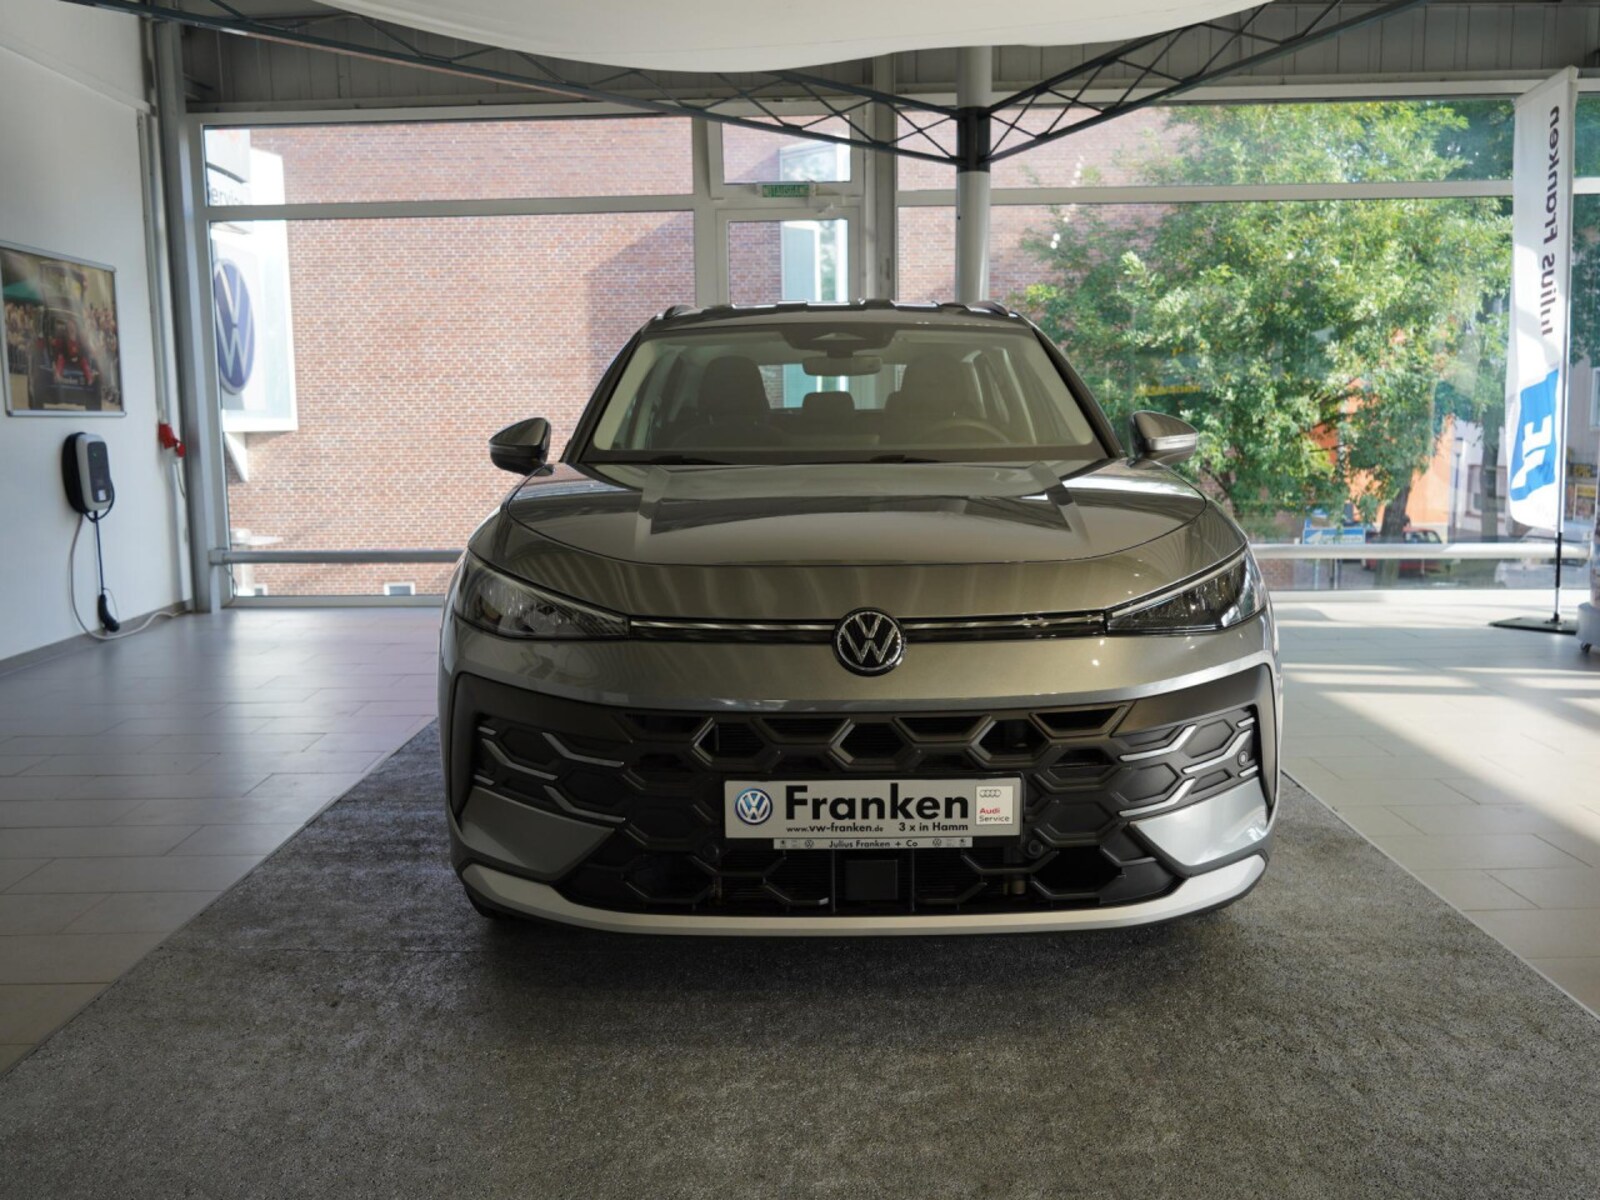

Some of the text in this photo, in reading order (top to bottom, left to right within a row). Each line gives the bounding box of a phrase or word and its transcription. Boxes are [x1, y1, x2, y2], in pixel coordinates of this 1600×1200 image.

[785, 783, 969, 820] Franken
[979, 815, 1010, 823] Service
[786, 822, 884, 833] www.vw-franken.de
[898, 822, 969, 832] 3 x in Hamm
[828, 840, 854, 849] Julius
[855, 839, 891, 848] Franken
[905, 838, 919, 848] Co
